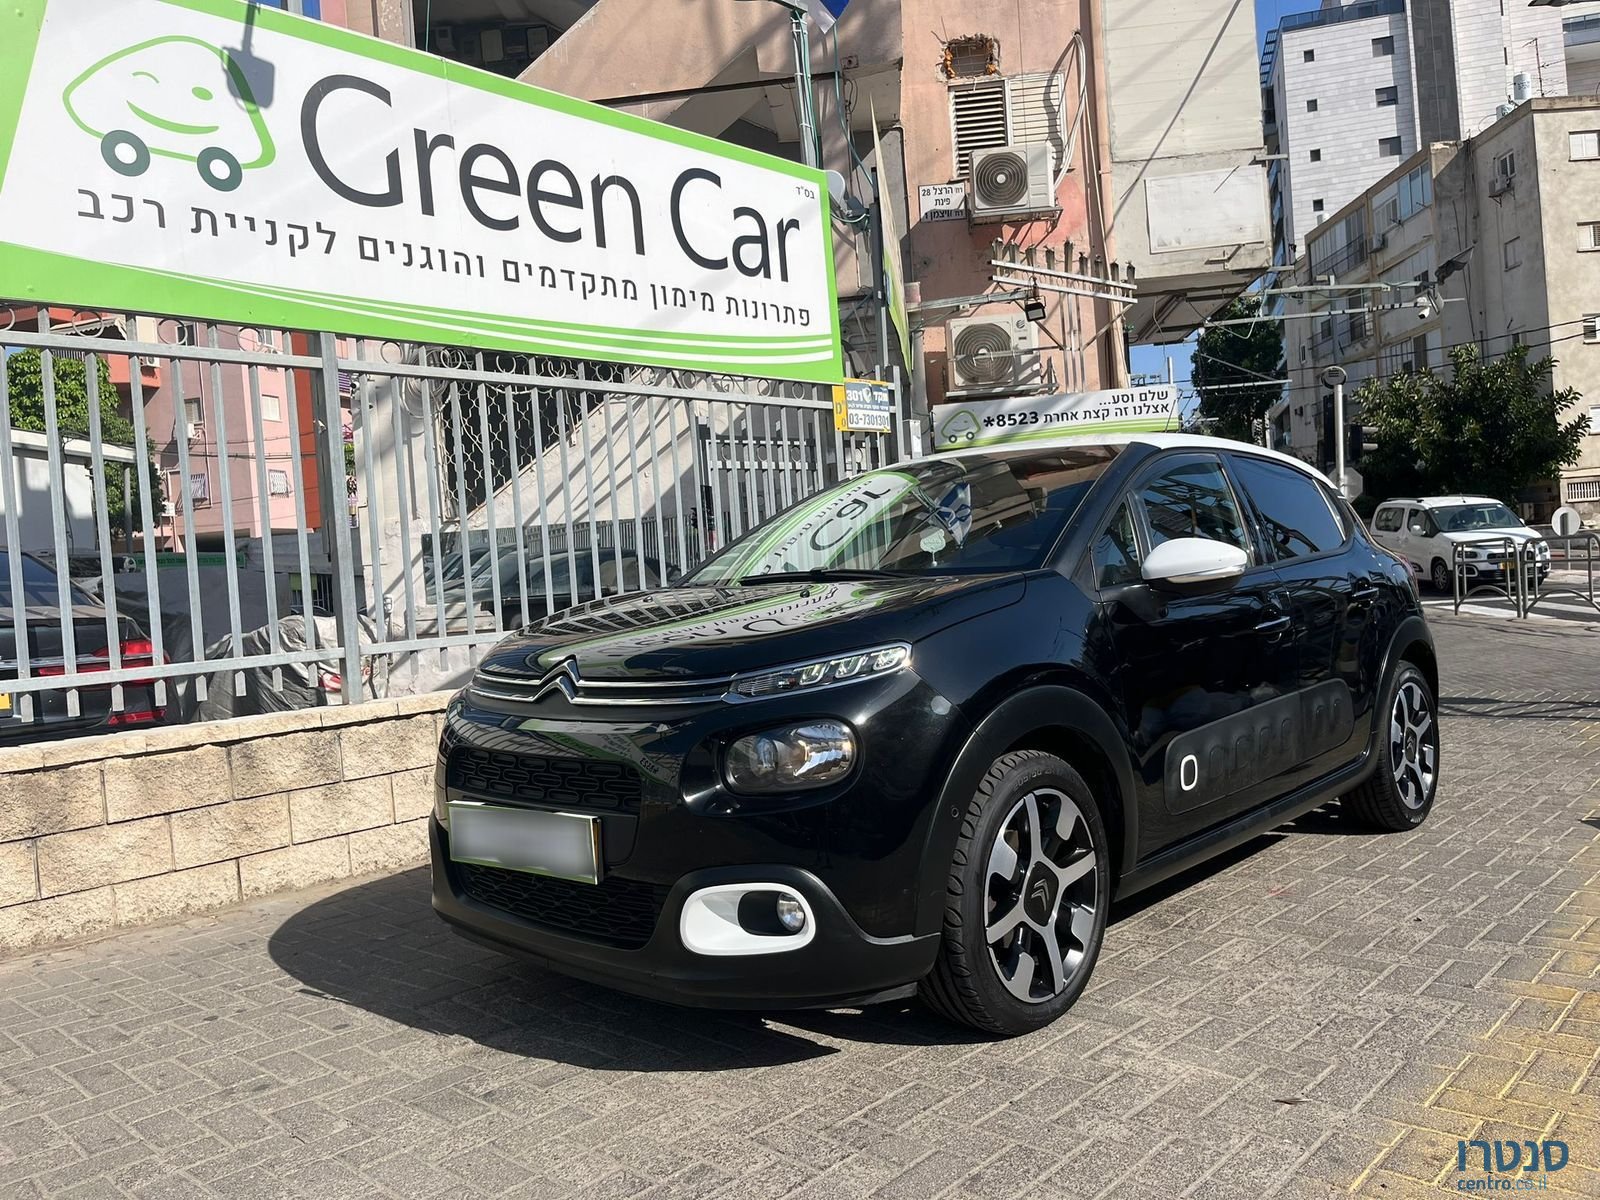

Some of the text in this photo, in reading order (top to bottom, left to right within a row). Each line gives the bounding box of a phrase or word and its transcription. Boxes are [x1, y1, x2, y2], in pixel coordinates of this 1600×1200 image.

[300, 74, 800, 282] Green Car
[795, 186, 815, 199] בס"ד
[921, 188, 931, 196] 28
[932, 186, 953, 195] הרצל
[934, 198, 951, 206] פינת
[77, 188, 810, 326] פתרונות מימון מתקדמים והוגנים לקניית רכב
[1139, 390, 1168, 402] שלם
[1084, 407, 1110, 420] קצת
[1114, 406, 1129, 416] זה
[1133, 403, 1170, 416] אצלנו
[1043, 411, 1078, 424] אחרת
